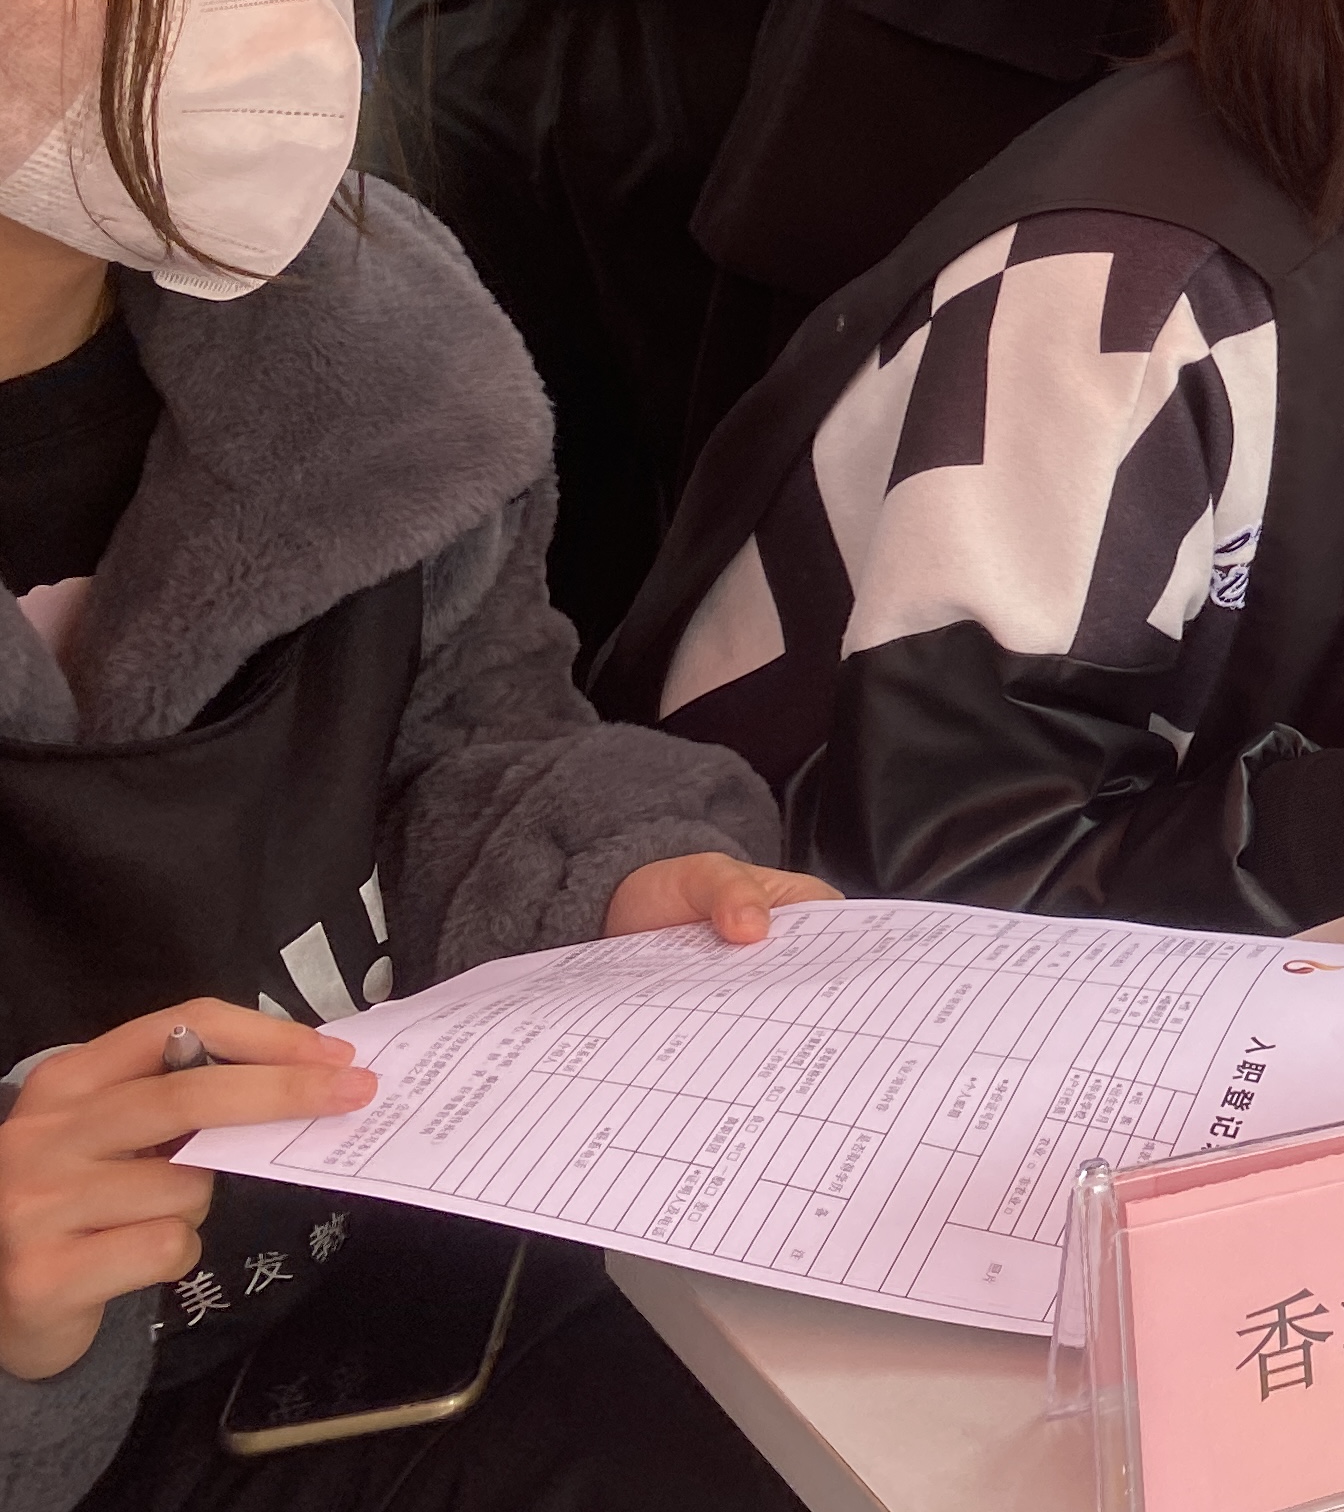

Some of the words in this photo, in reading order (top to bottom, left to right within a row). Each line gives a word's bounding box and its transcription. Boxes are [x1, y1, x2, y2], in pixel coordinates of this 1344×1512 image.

[827, 1132, 873, 1193] 是否取得学历
